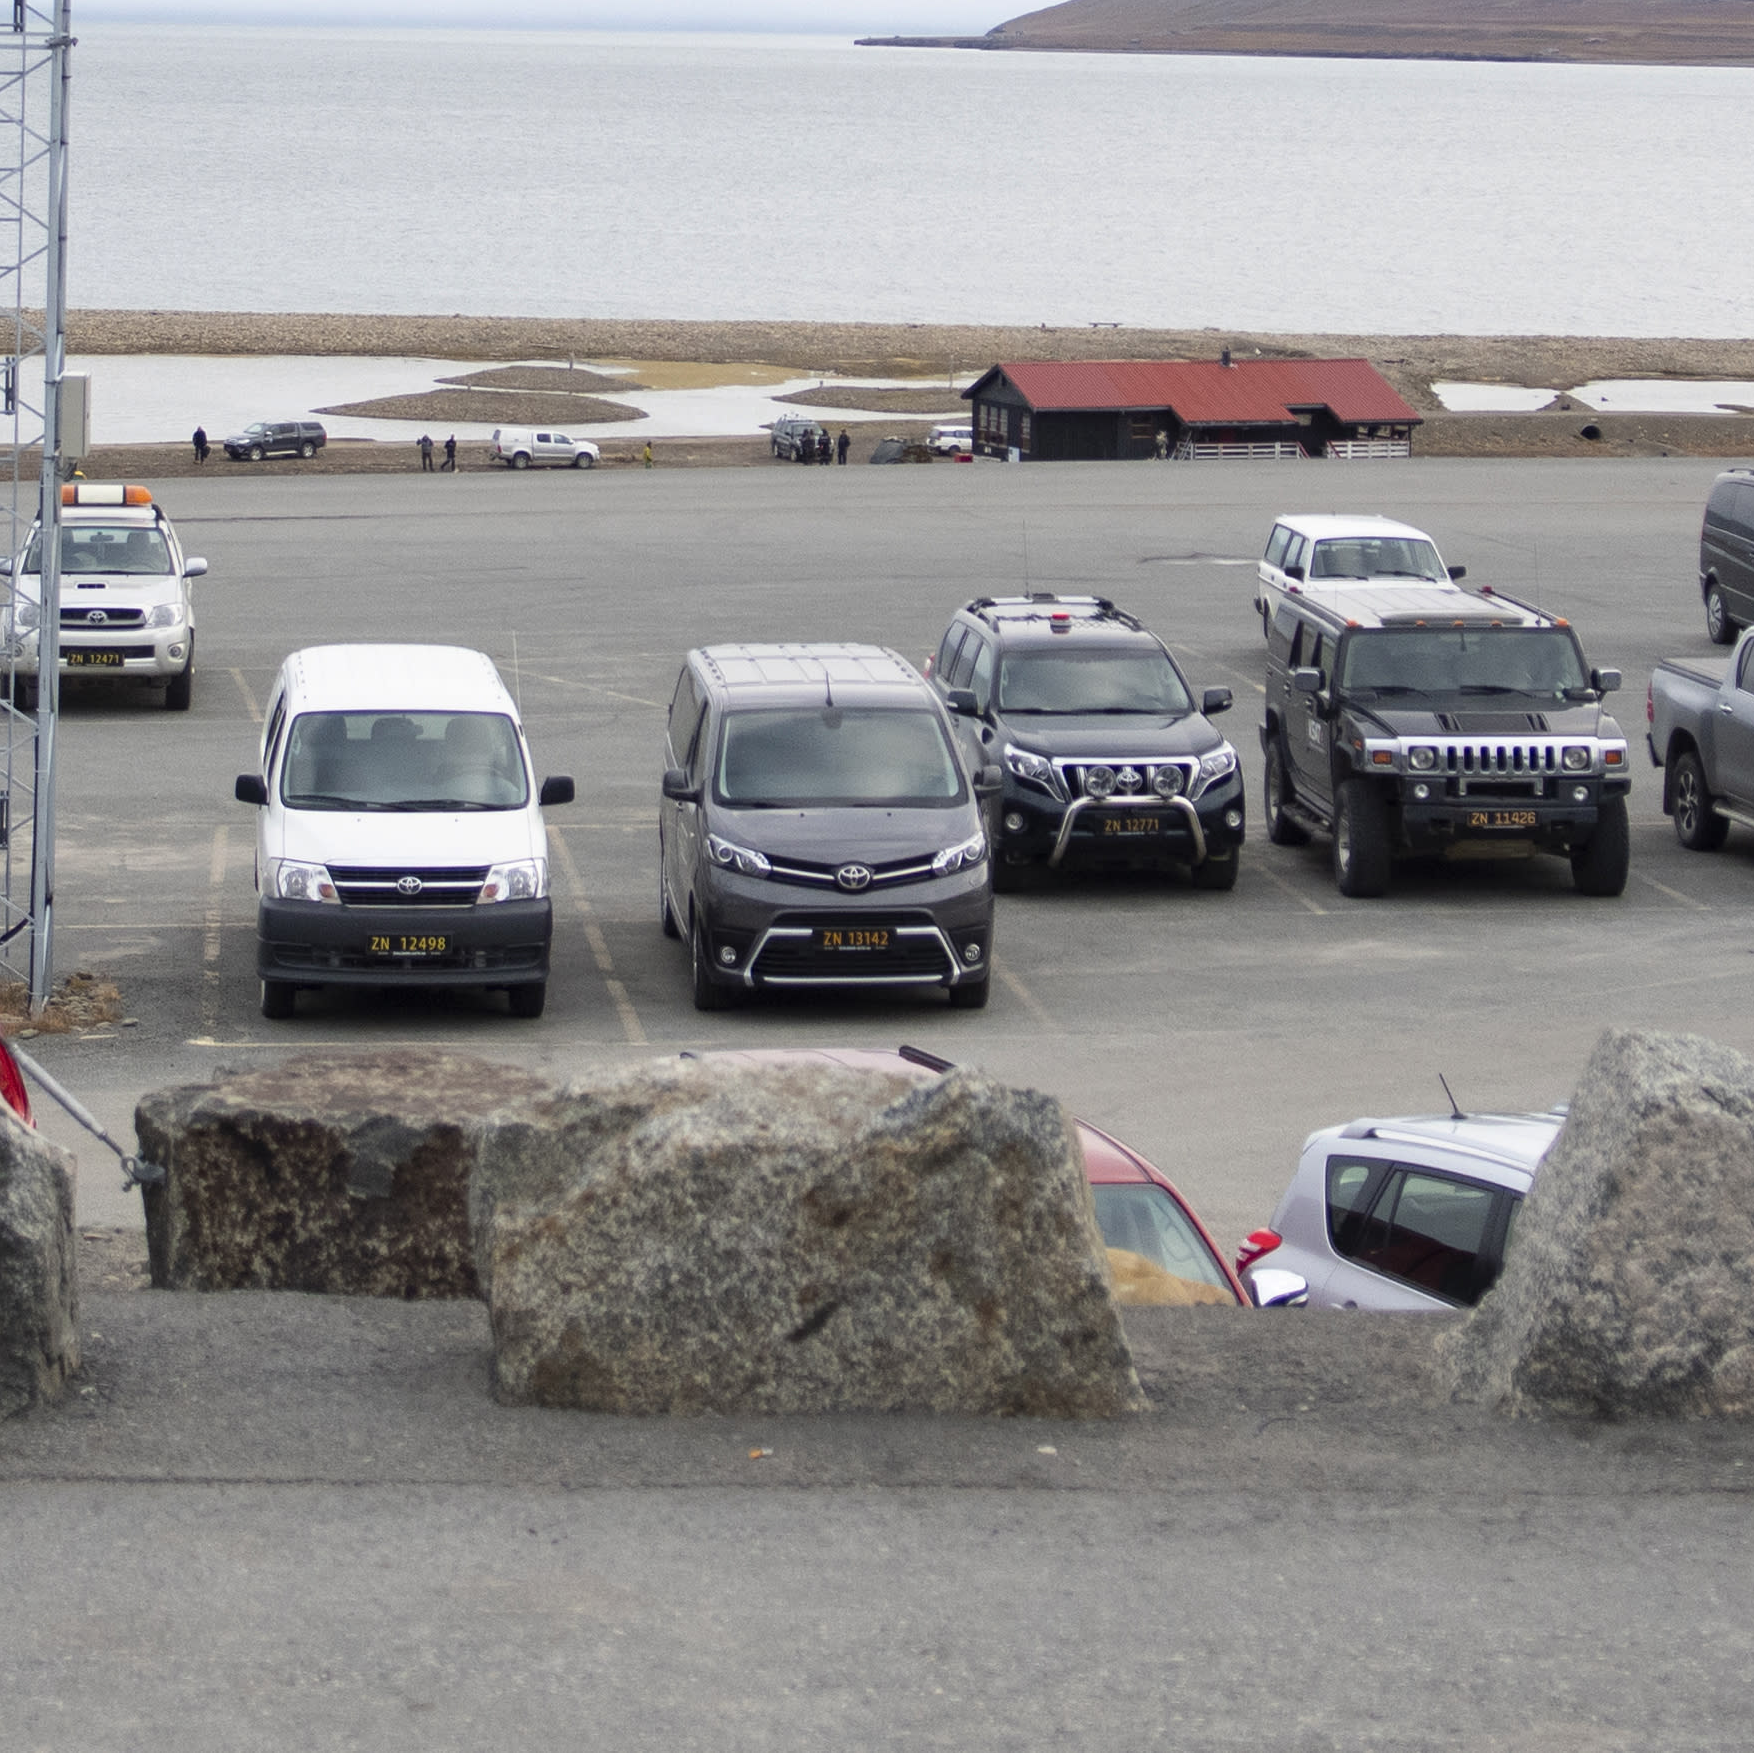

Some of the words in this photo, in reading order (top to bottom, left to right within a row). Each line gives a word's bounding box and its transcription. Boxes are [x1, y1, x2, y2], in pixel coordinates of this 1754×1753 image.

[70, 654, 84, 664] ZN
[90, 654, 119, 664] 12471
[1105, 819, 1121, 832] ZN
[1126, 818, 1159, 832] 12771
[1471, 812, 1488, 825] ZN
[1495, 811, 1536, 825] 11426
[371, 936, 390, 951] ZN
[400, 936, 446, 951] 12498
[823, 931, 842, 946] ZN
[848, 931, 889, 946] 13142
